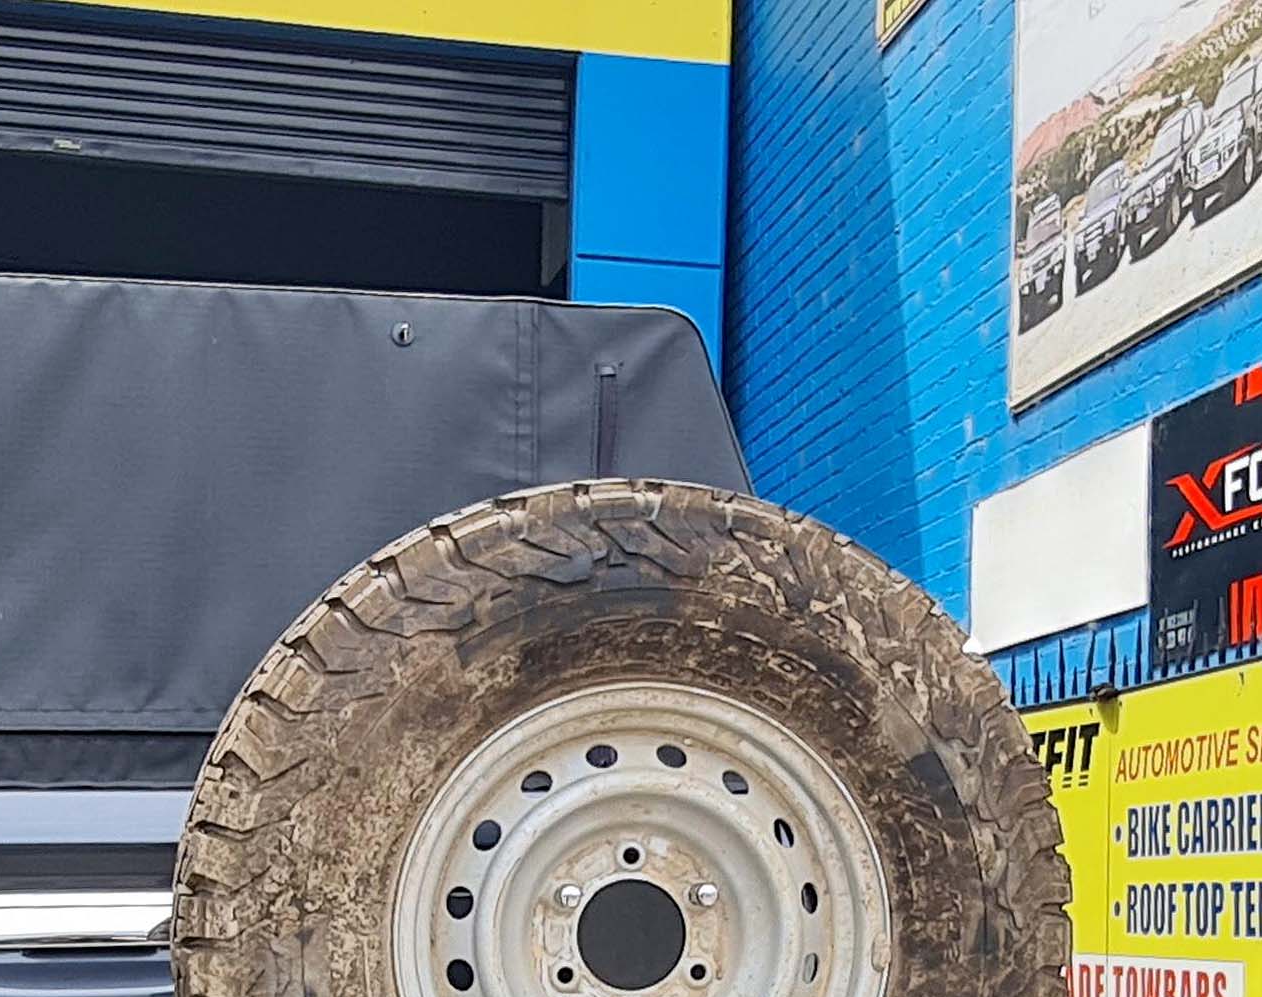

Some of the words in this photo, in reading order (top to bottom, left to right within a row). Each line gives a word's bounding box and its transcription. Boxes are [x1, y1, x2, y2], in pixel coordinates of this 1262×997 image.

[1115, 728, 1240, 783] AUTOMOTIVE
[1128, 804, 1171, 857] BIKE
[1178, 794, 1262, 855] CARRIE
[1127, 883, 1177, 935] ROOF
[1182, 882, 1224, 936] TOP
[1230, 881, 1262, 937] TE
